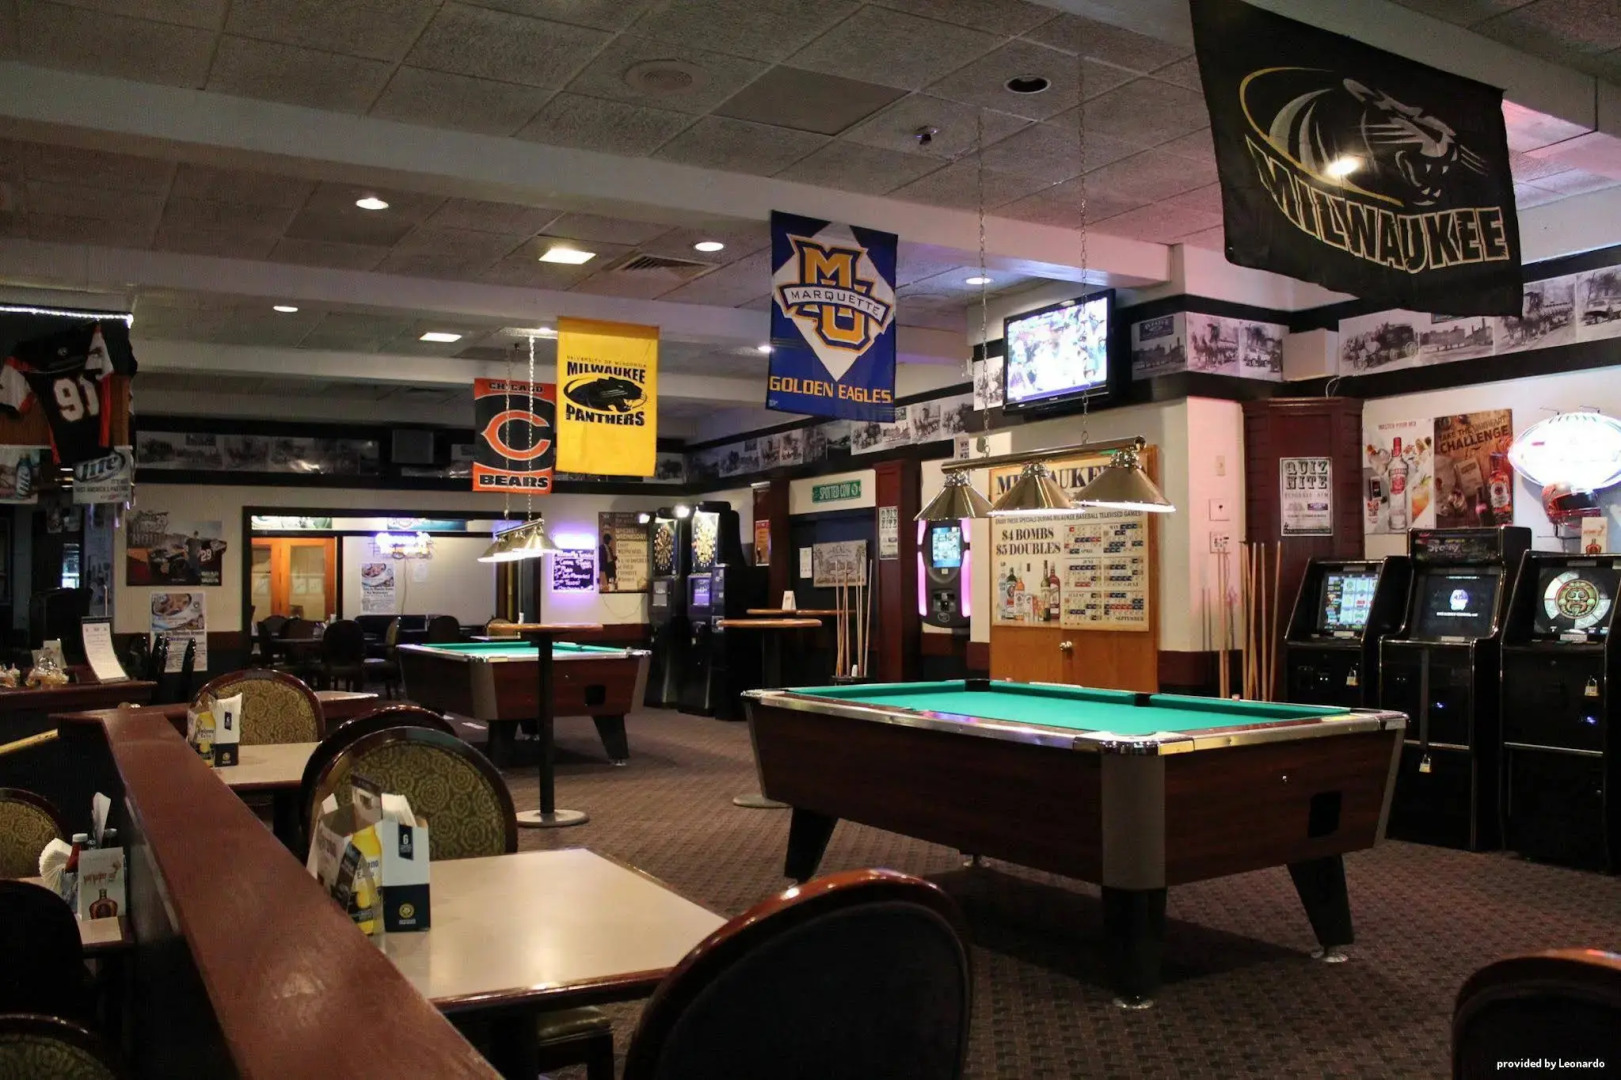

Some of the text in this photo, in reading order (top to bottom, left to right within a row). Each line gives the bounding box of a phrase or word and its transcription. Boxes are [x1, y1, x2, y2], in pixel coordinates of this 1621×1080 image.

[1245, 133, 1510, 274] MILWAUKEE
[790, 289, 881, 317] MARQUETTE
[567, 361, 646, 384] MILWAUKEE
[54, 374, 100, 422] 91
[769, 375, 893, 404] GOLDEN EAGLES
[566, 403, 645, 426] PANTHERS
[1440, 425, 1509, 454] CHALLENGE
[1285, 460, 1328, 476] QUIZ
[479, 474, 549, 488] BEARS
[1285, 475, 1328, 490] NITE
[1001, 527, 1055, 541] $4 BOMBS
[995, 542, 1062, 555] $5 DOUBLES
